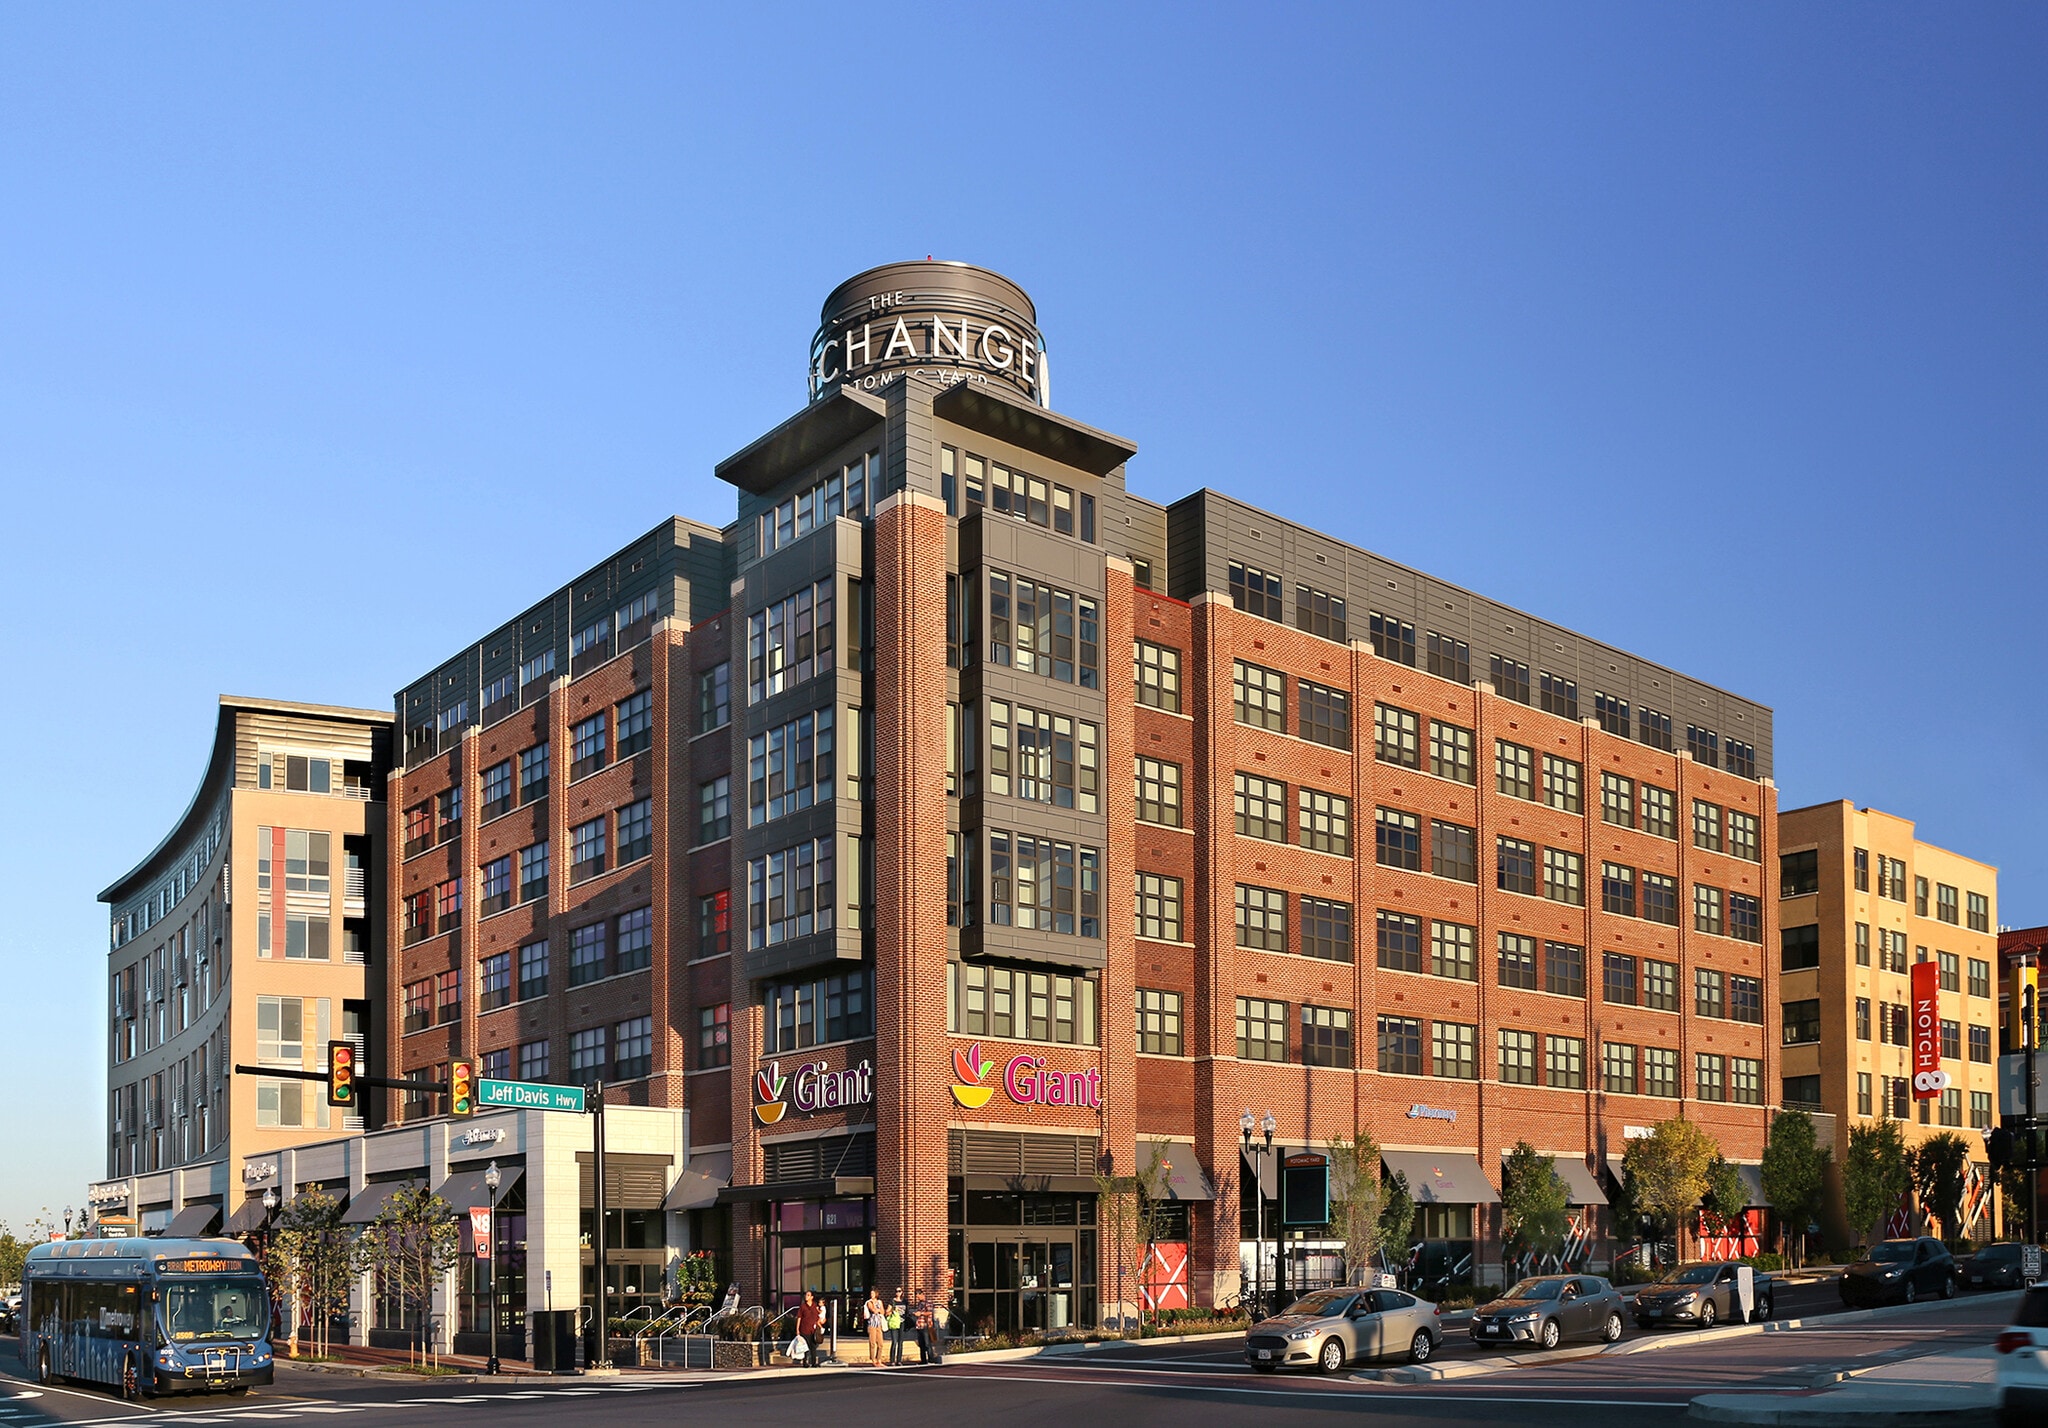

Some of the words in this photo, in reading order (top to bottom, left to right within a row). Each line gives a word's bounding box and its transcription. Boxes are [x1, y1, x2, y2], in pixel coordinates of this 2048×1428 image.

[869, 291, 903, 310] THE
[1918, 1000, 1933, 1067] NOTCH
[793, 1059, 873, 1112] Giant
[1004, 1054, 1102, 1107] Giant
[1915, 1070, 1949, 1091] 8
[487, 1084, 513, 1102] Jeff
[515, 1087, 550, 1105] Davis
[556, 1094, 577, 1109] Hwy
[471, 1213, 490, 1234] N8
[826, 1214, 837, 1224] 621
[184, 1260, 227, 1273] METROWAY
